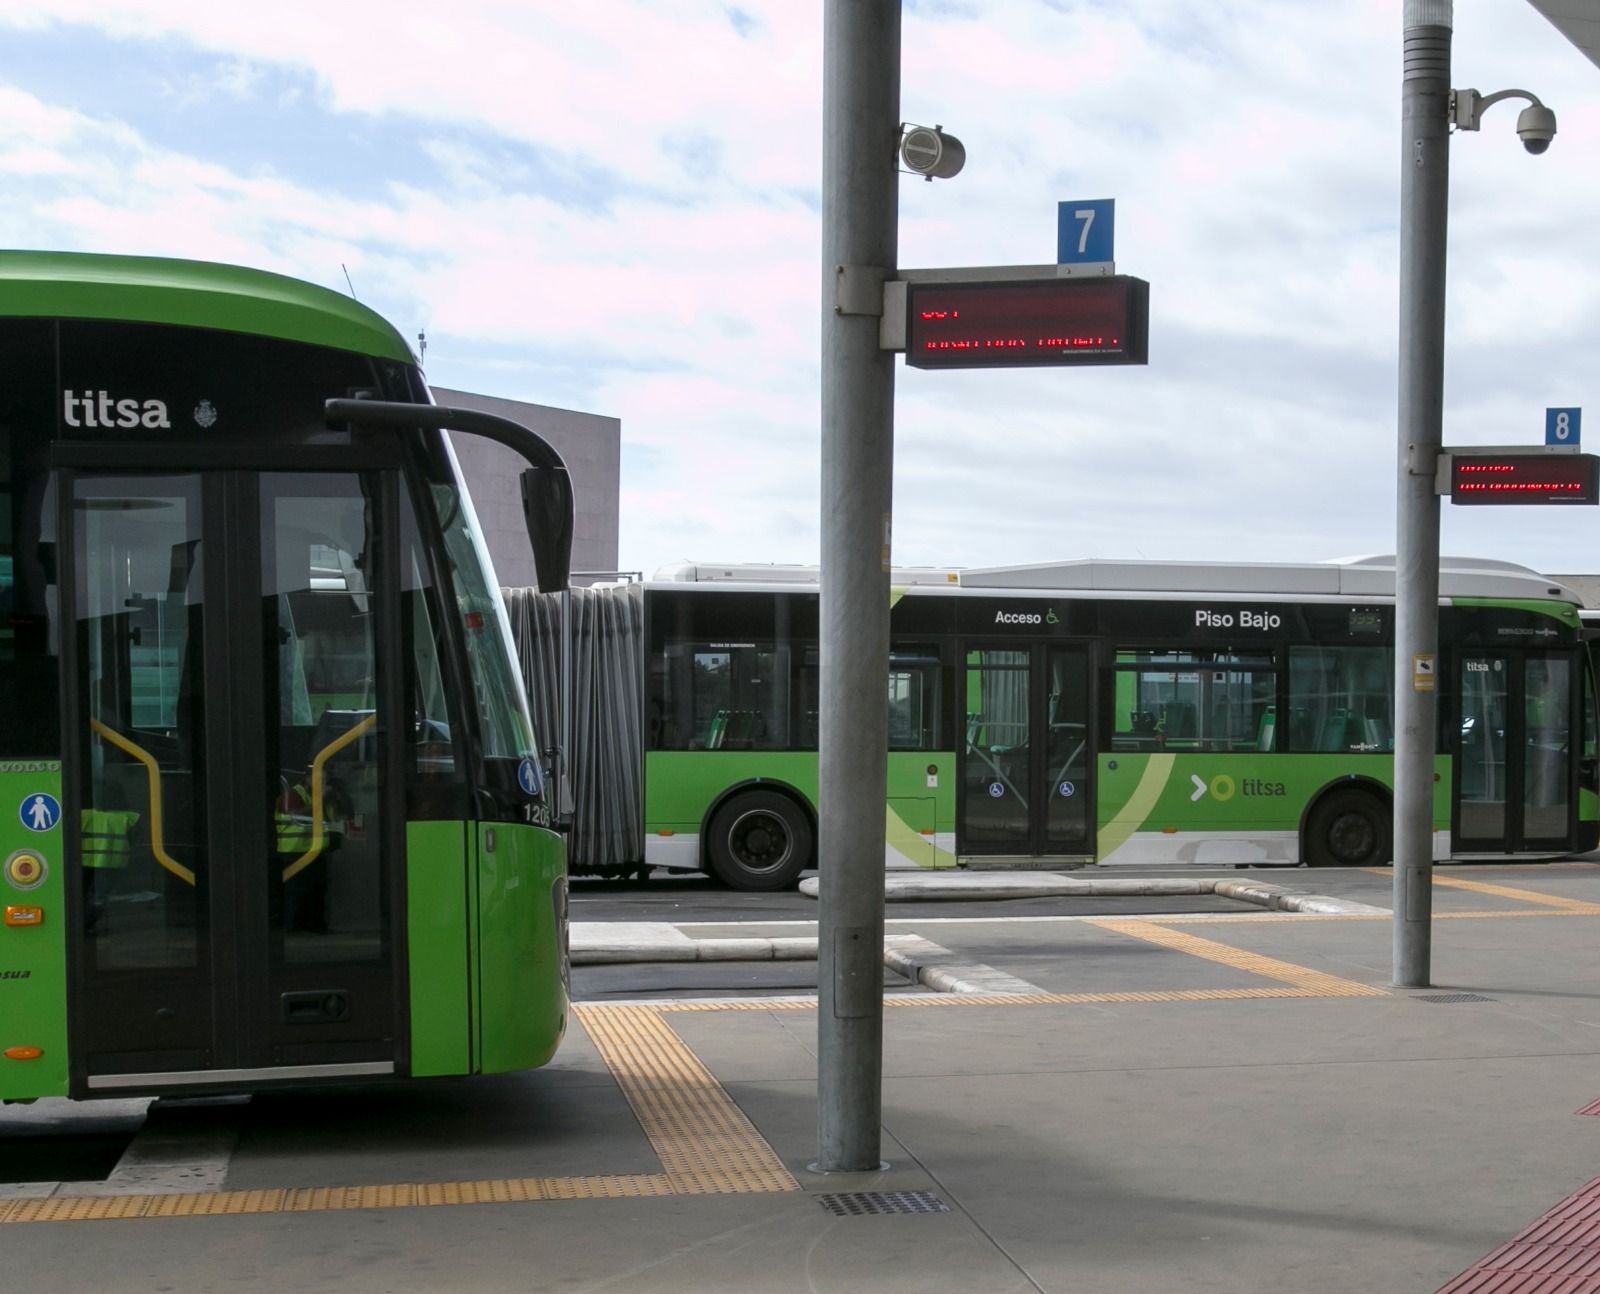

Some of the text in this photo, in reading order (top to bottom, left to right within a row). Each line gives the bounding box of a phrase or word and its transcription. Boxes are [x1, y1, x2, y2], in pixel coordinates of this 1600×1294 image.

[1074, 209, 1095, 253] 7
[63, 389, 170, 429] titsa
[1555, 412, 1569, 440] 8
[995, 610, 1041, 624] Acceso
[1195, 609, 1281, 630] Piso Bajo
[1466, 661, 1489, 672] titsa
[1242, 778, 1287, 797] titsa
[0, 970, 31, 980] sua
